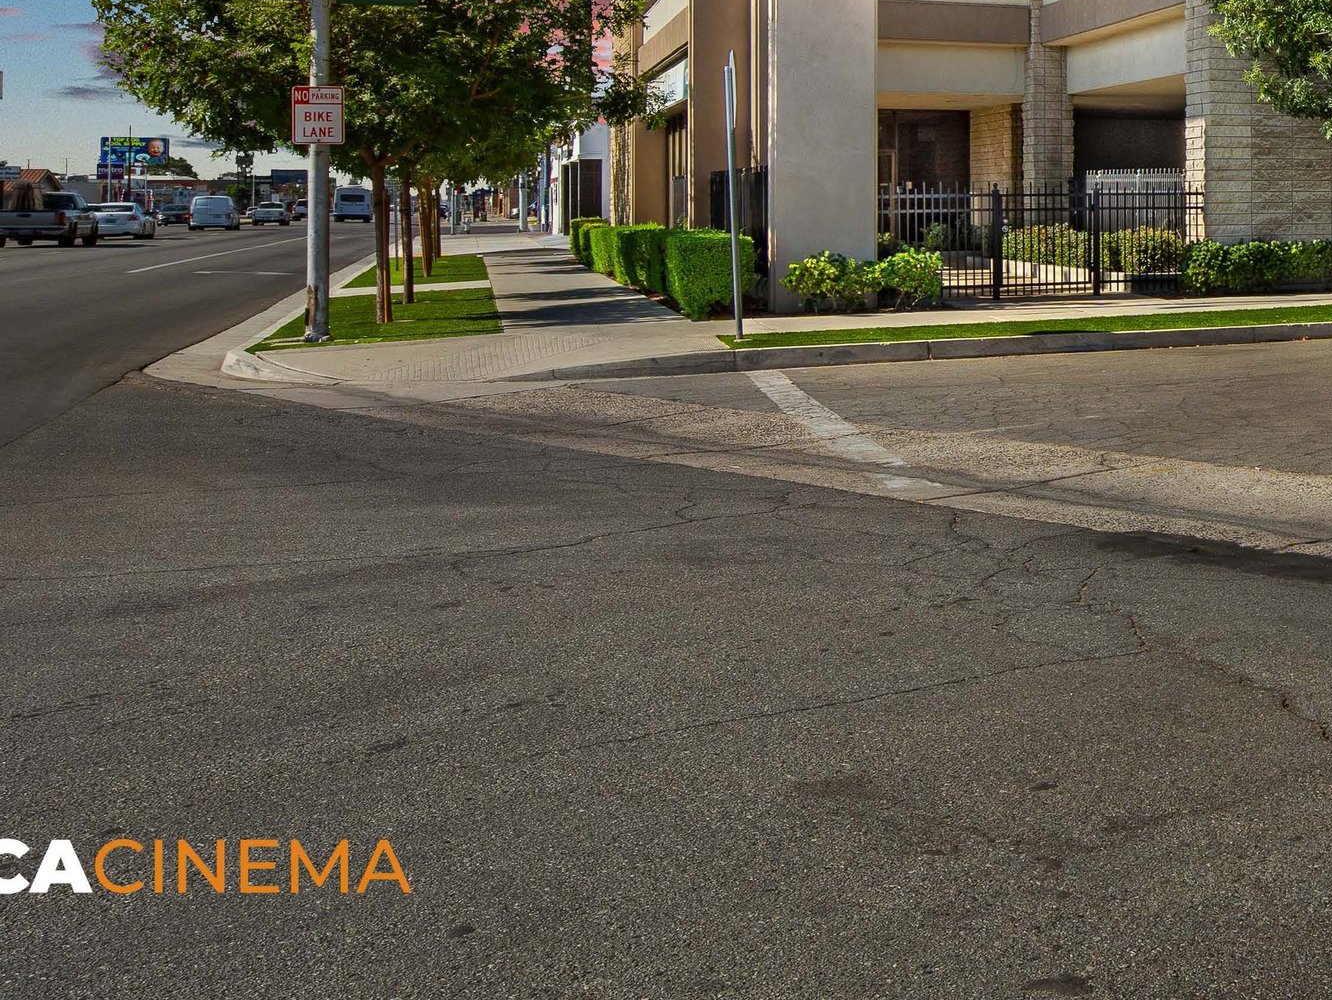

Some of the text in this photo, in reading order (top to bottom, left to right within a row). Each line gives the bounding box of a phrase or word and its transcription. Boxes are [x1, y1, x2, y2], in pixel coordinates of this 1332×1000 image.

[294, 90, 340, 102] NO PARKING
[304, 111, 333, 122] BIKE
[303, 127, 335, 138] LANE
